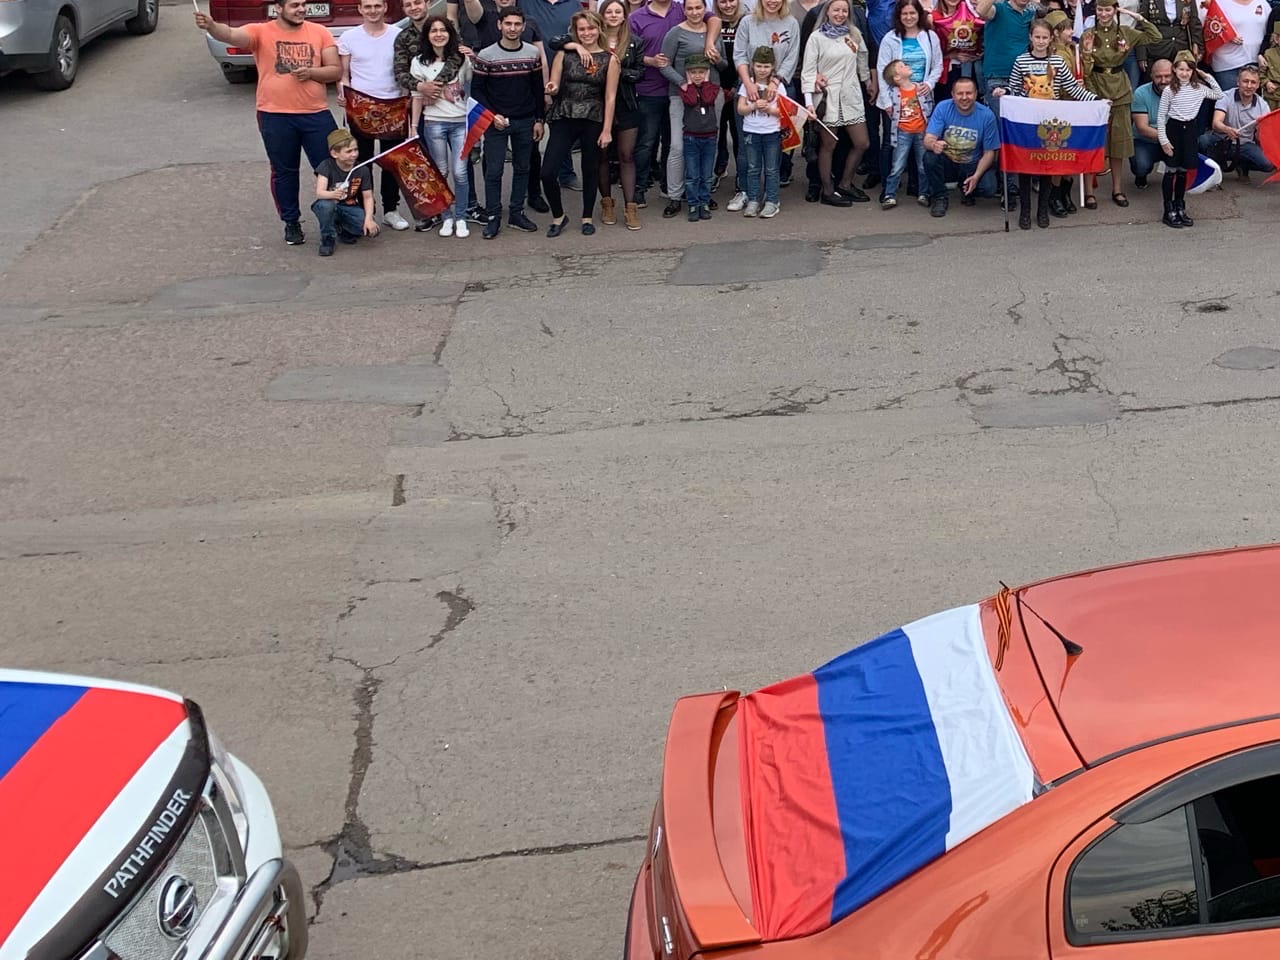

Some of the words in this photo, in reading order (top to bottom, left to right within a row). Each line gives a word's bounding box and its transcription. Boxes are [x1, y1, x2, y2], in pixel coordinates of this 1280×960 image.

[945, 127, 977, 142] 1945
[1029, 151, 1076, 160] РОССИЯ
[103, 788, 192, 898] PATHFINDER
